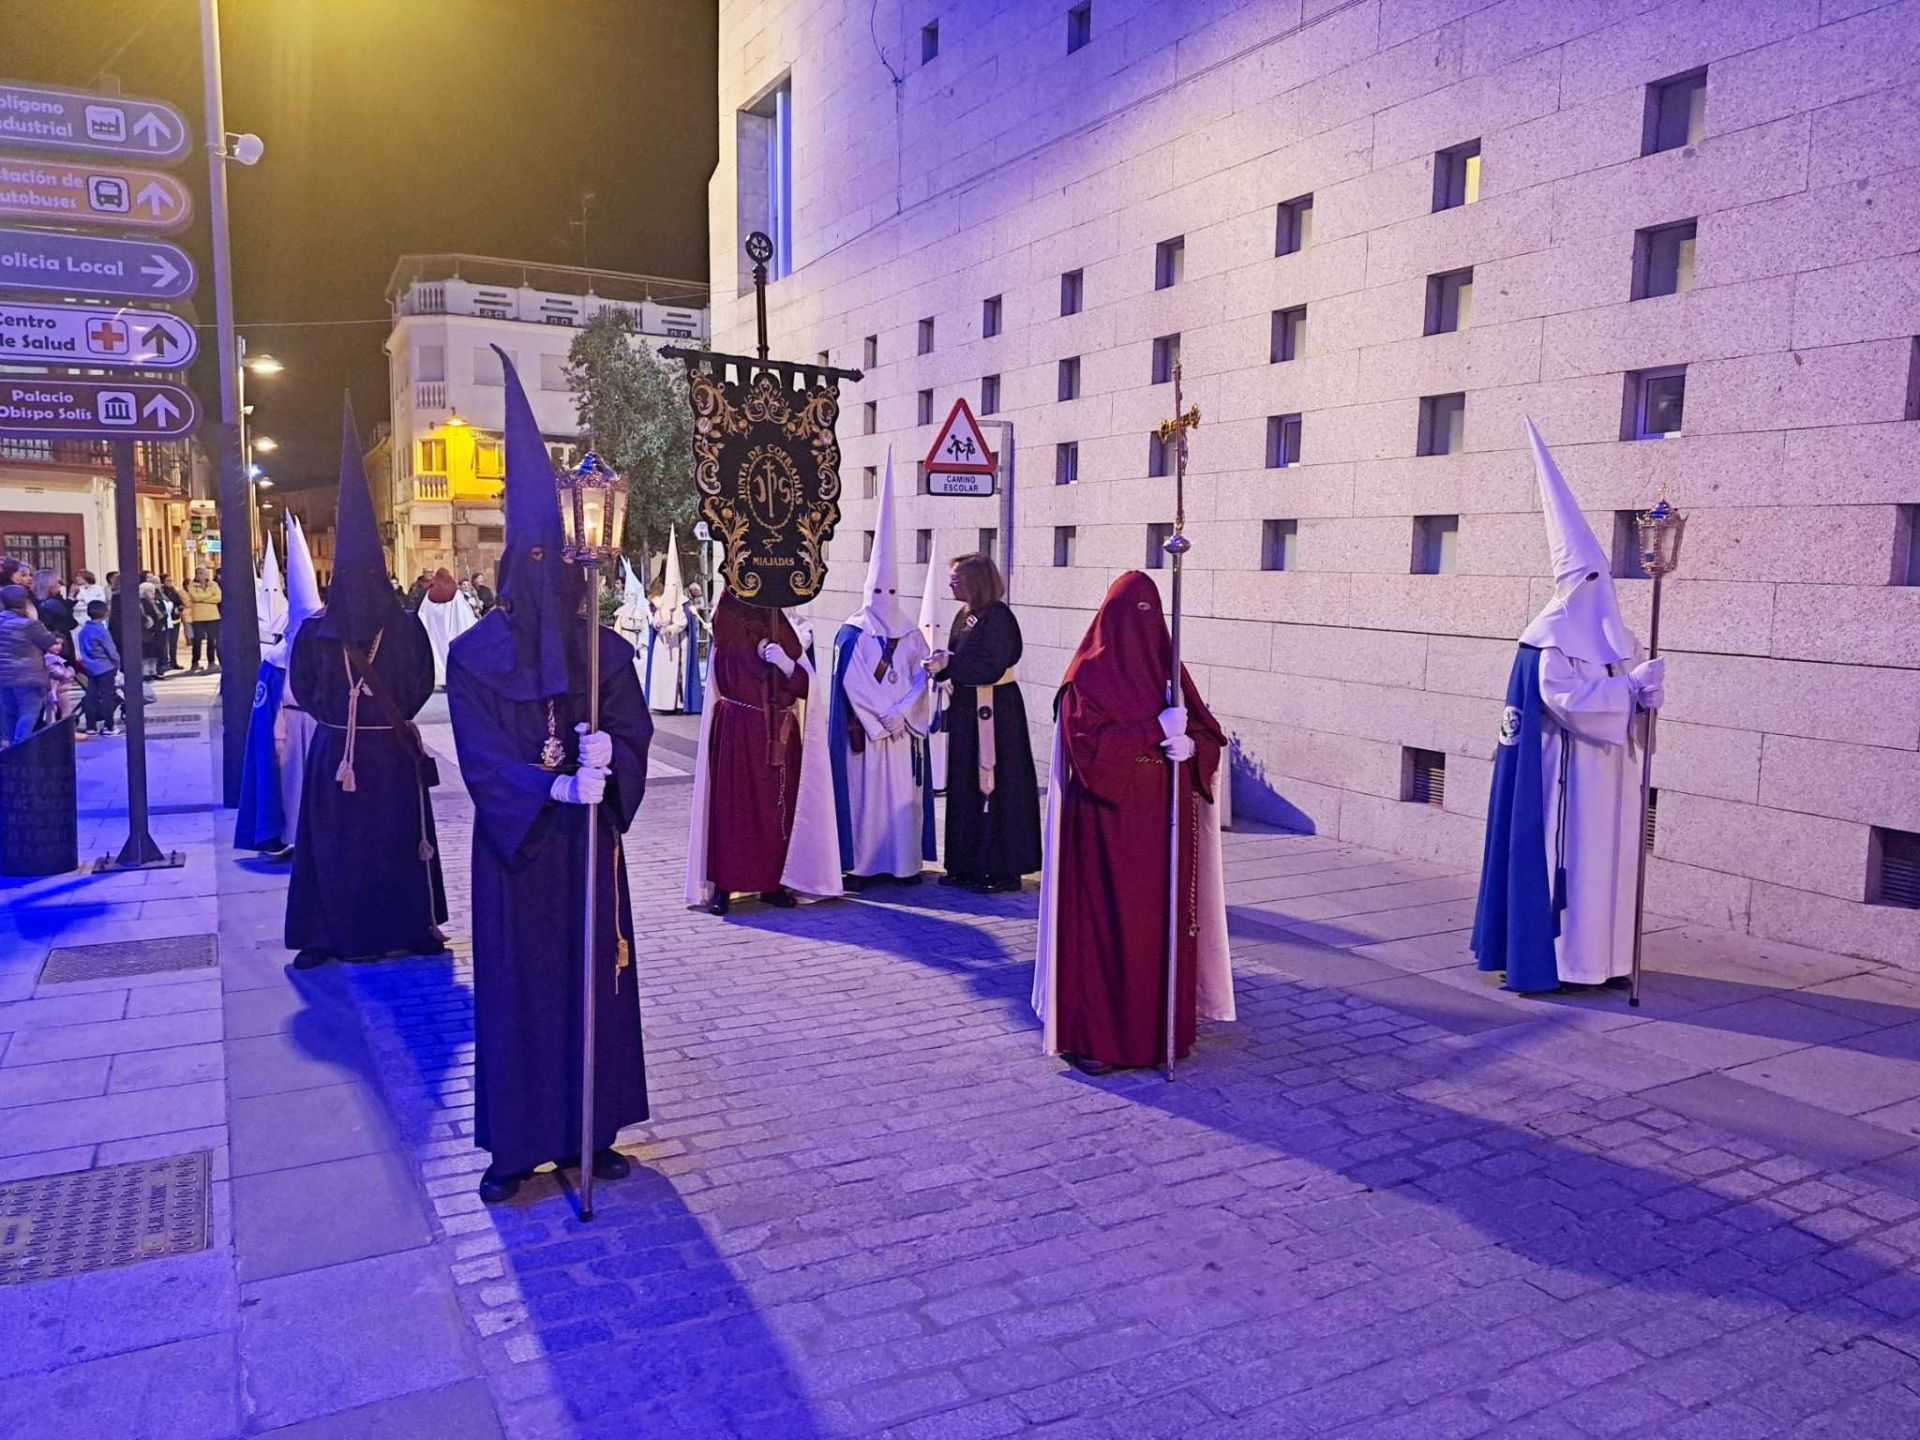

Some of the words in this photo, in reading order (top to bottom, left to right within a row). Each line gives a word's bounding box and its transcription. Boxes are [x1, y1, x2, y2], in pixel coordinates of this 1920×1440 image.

[0, 116, 73, 137] dustrial
[0, 168, 57, 186] tación
[62, 172, 83, 188] de
[67, 256, 124, 276] Local
[0, 312, 56, 329] entro
[22, 334, 76, 351] Salud
[11, 389, 74, 403] Palacio
[0, 405, 54, 421] Obispo
[58, 408, 92, 420] Solís
[738, 463, 750, 501] JUNTA
[748, 445, 763, 460] DE
[946, 475, 976, 484] CAMINO
[943, 483, 978, 492] ESCOLAR
[752, 556, 795, 567] MIAJADAS
